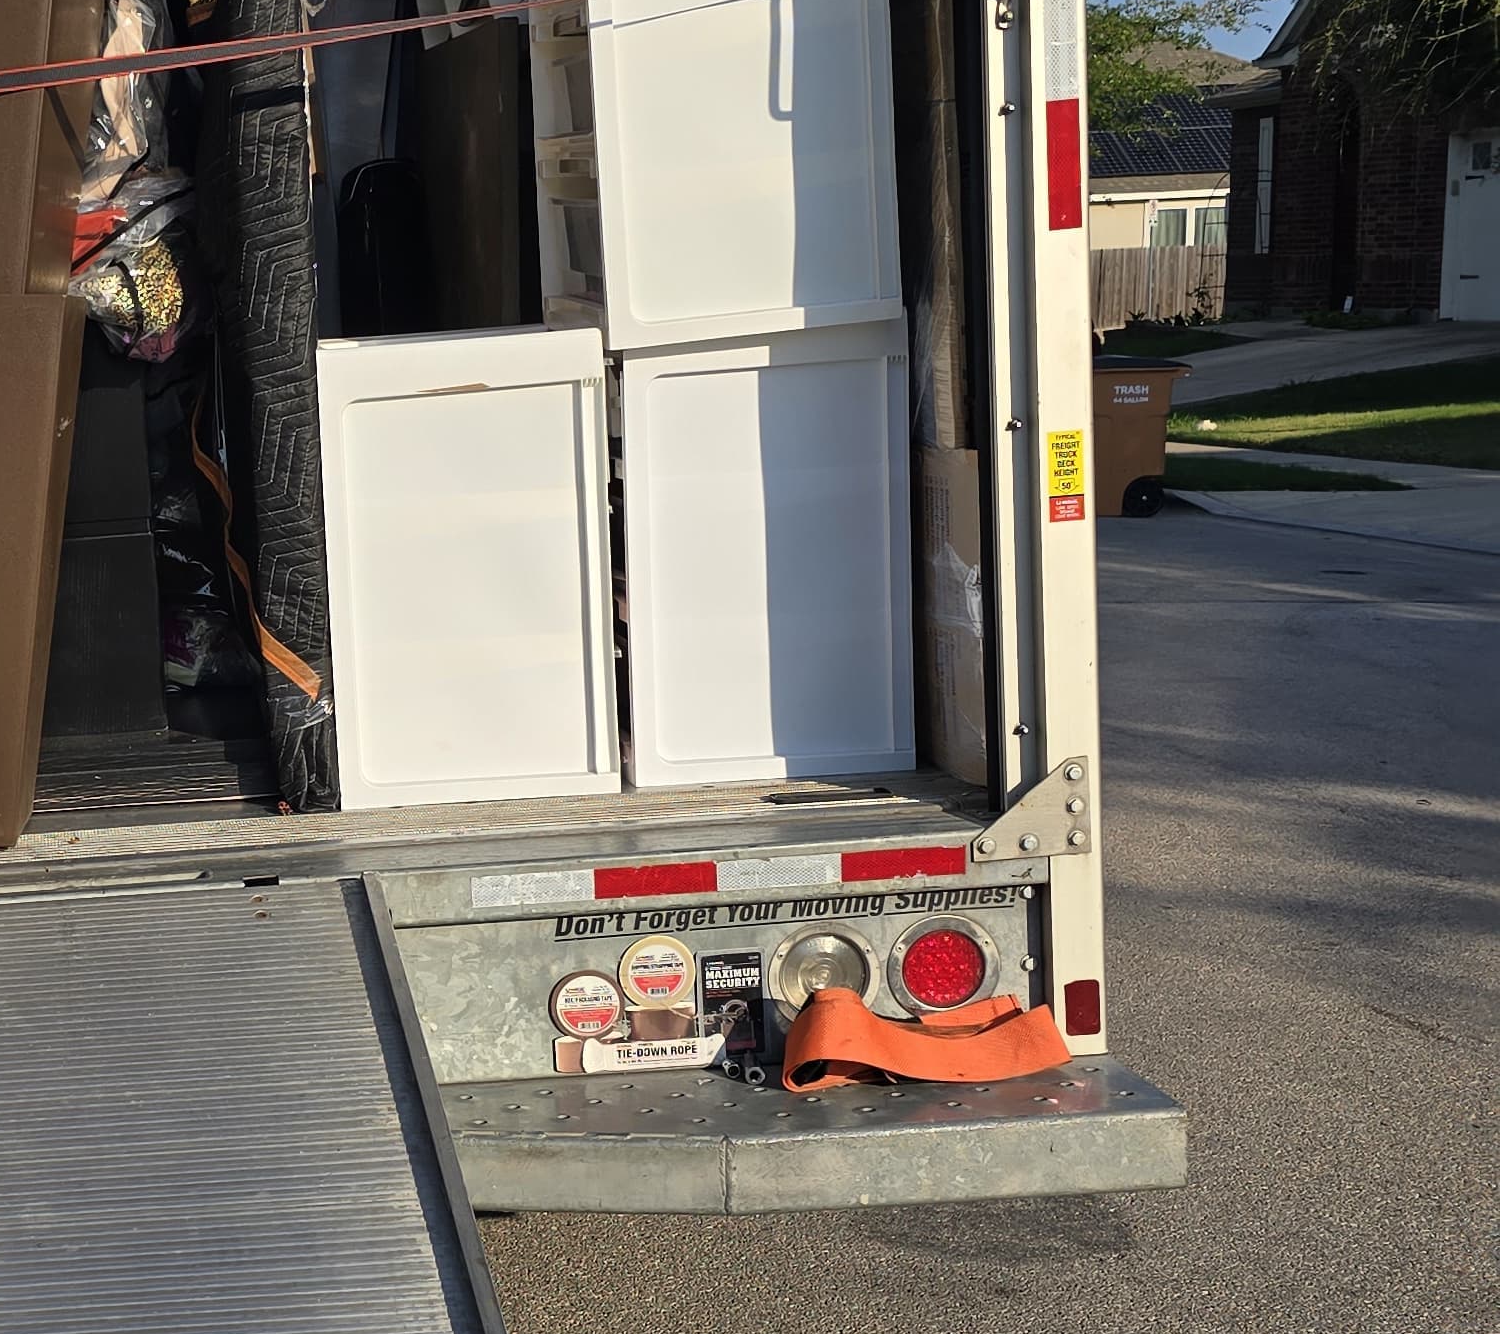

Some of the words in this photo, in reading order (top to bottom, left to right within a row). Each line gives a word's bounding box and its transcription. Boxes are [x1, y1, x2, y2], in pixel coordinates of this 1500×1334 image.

[1113, 384, 1149, 395] TRASH
[1051, 441, 1080, 450] FREIGHT
[1055, 450, 1077, 459] TRUCK
[1057, 460, 1075, 468] DECK
[1054, 468, 1079, 478] HEIGHT
[555, 912, 625, 937] Don't
[634, 907, 718, 932] Forget
[728, 902, 782, 922] Your
[791, 895, 886, 917] Moving
[705, 968, 760, 979] MAXIMUM
[705, 977, 761, 989] SECURITY
[616, 1046, 668, 1059] TIE-DOWN
[670, 1044, 698, 1055] ROPE
